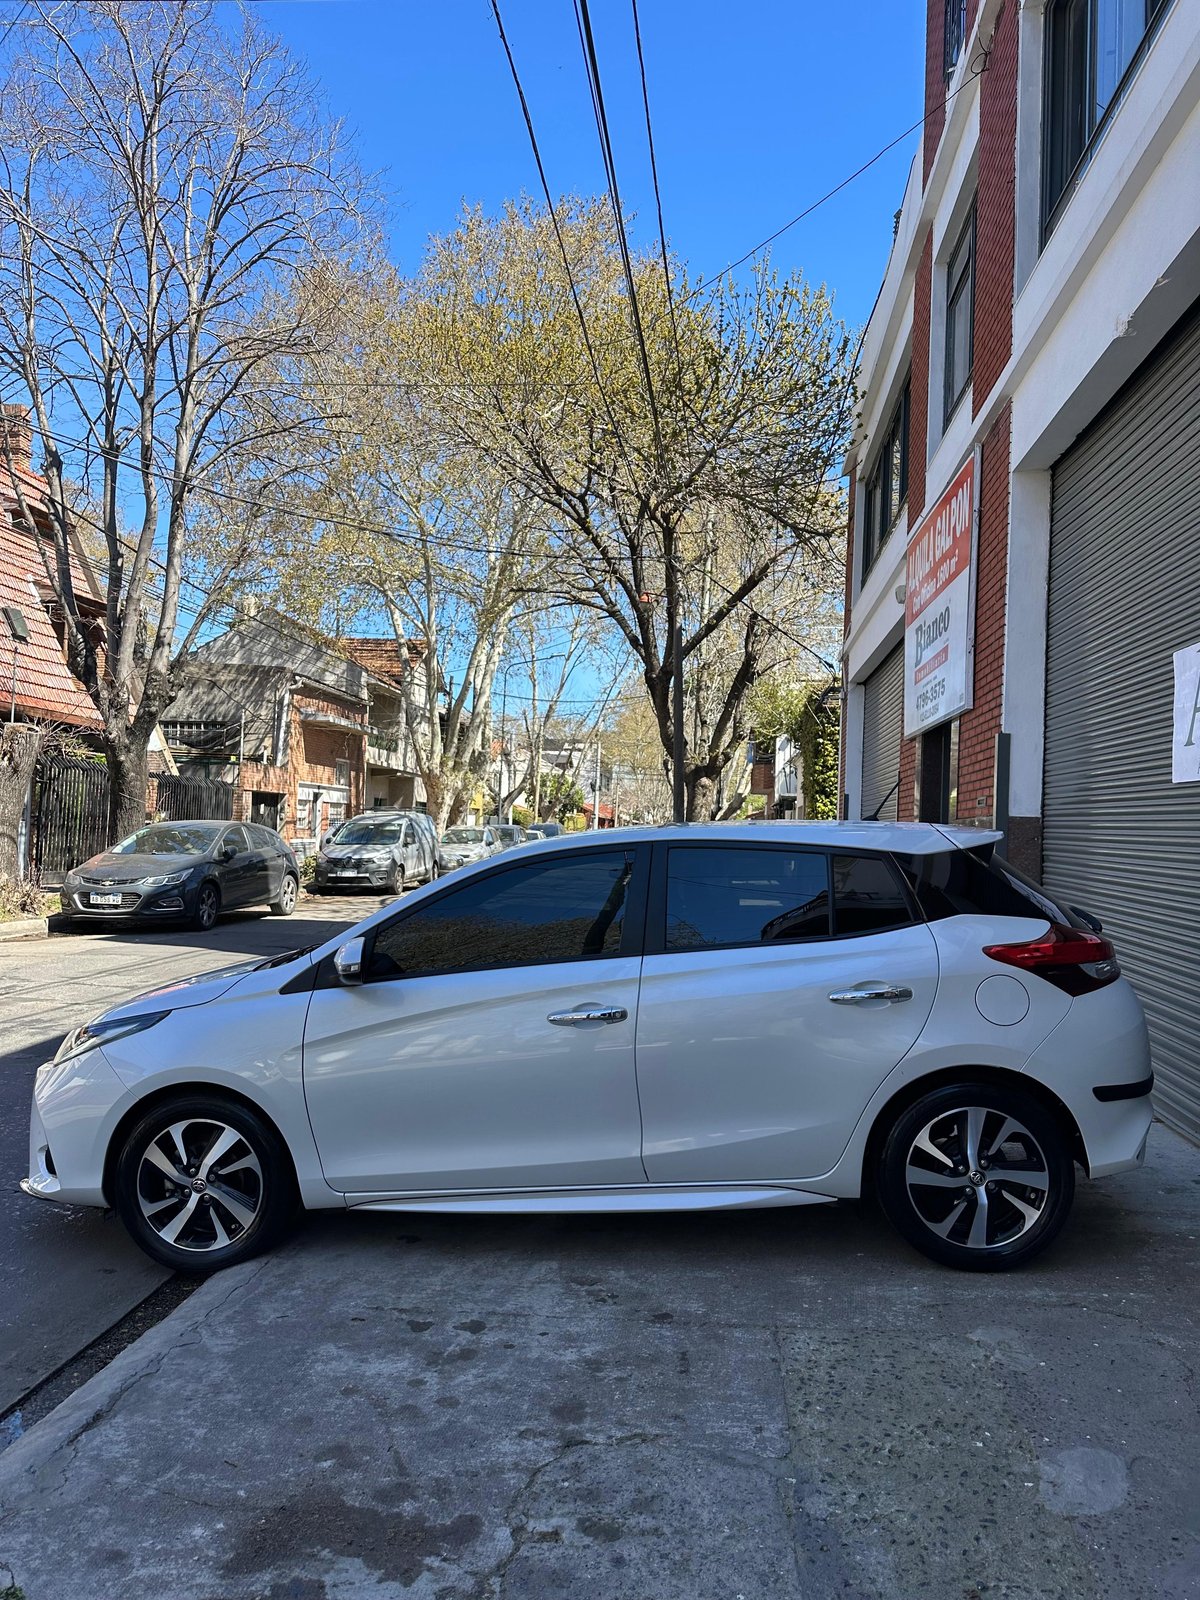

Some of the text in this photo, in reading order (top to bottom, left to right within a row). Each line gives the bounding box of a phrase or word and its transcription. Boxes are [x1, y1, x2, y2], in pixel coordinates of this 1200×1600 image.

[935, 477, 971, 562] GALPON
[914, 605, 950, 669] Bianco
[915, 677, 946, 710] 4796-3575
